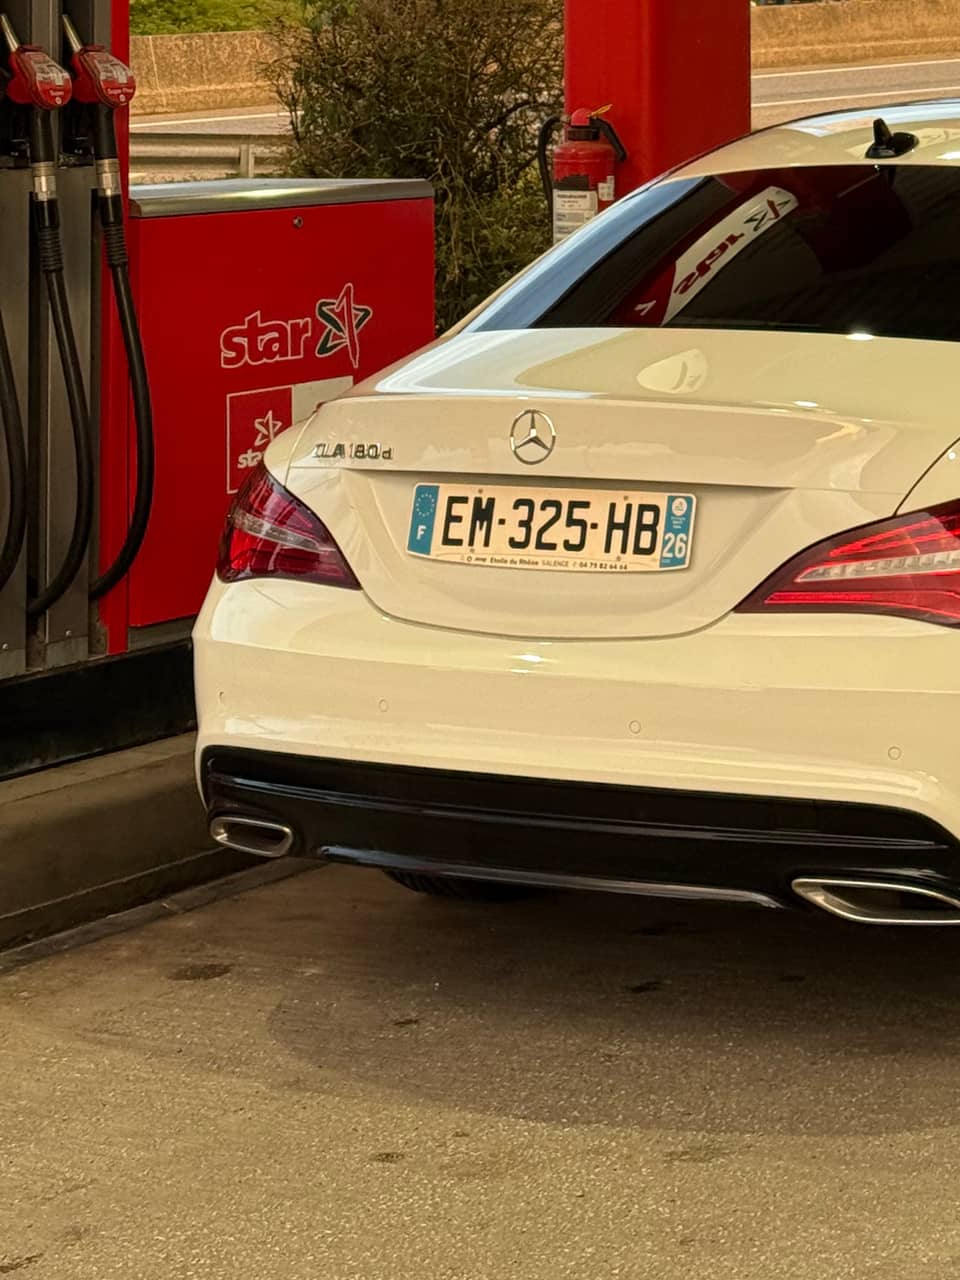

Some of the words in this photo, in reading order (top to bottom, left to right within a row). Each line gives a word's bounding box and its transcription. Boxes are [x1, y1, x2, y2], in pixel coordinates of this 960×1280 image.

[220, 310, 312, 368] star
[237, 449, 263, 469] sta
[416, 525, 426, 540] F
[441, 496, 661, 555] EM-325-HB
[662, 532, 687, 558] 26
